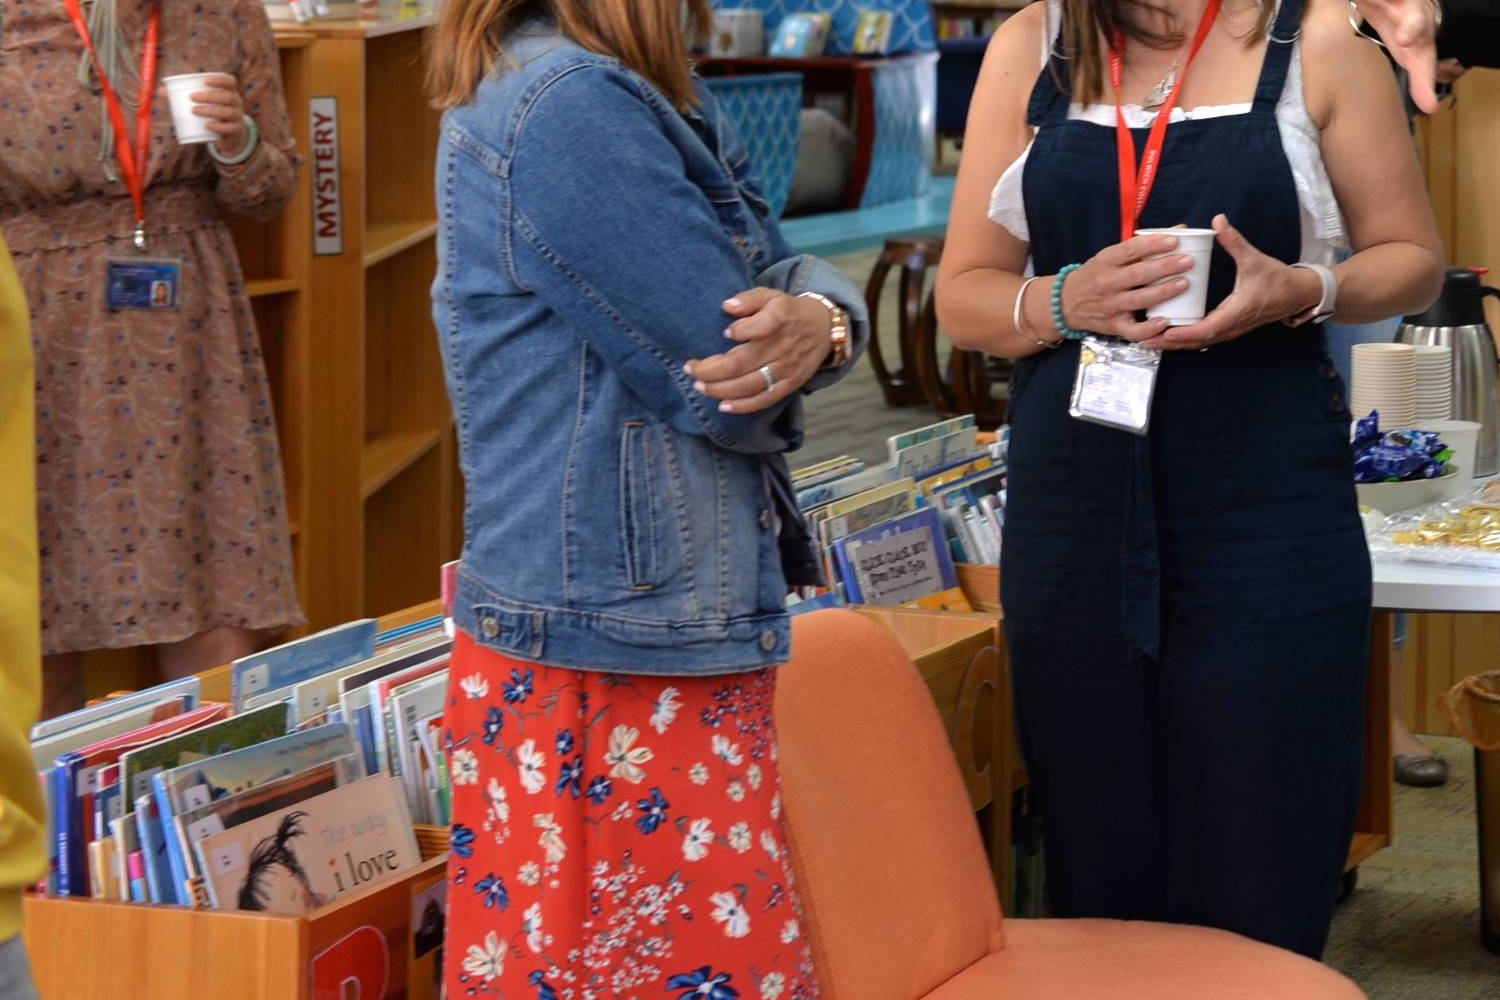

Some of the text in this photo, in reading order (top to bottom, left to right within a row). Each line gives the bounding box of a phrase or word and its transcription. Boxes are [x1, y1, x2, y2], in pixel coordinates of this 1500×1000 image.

[313, 111, 337, 239] MYSTERY
[328, 848, 400, 893] i love
